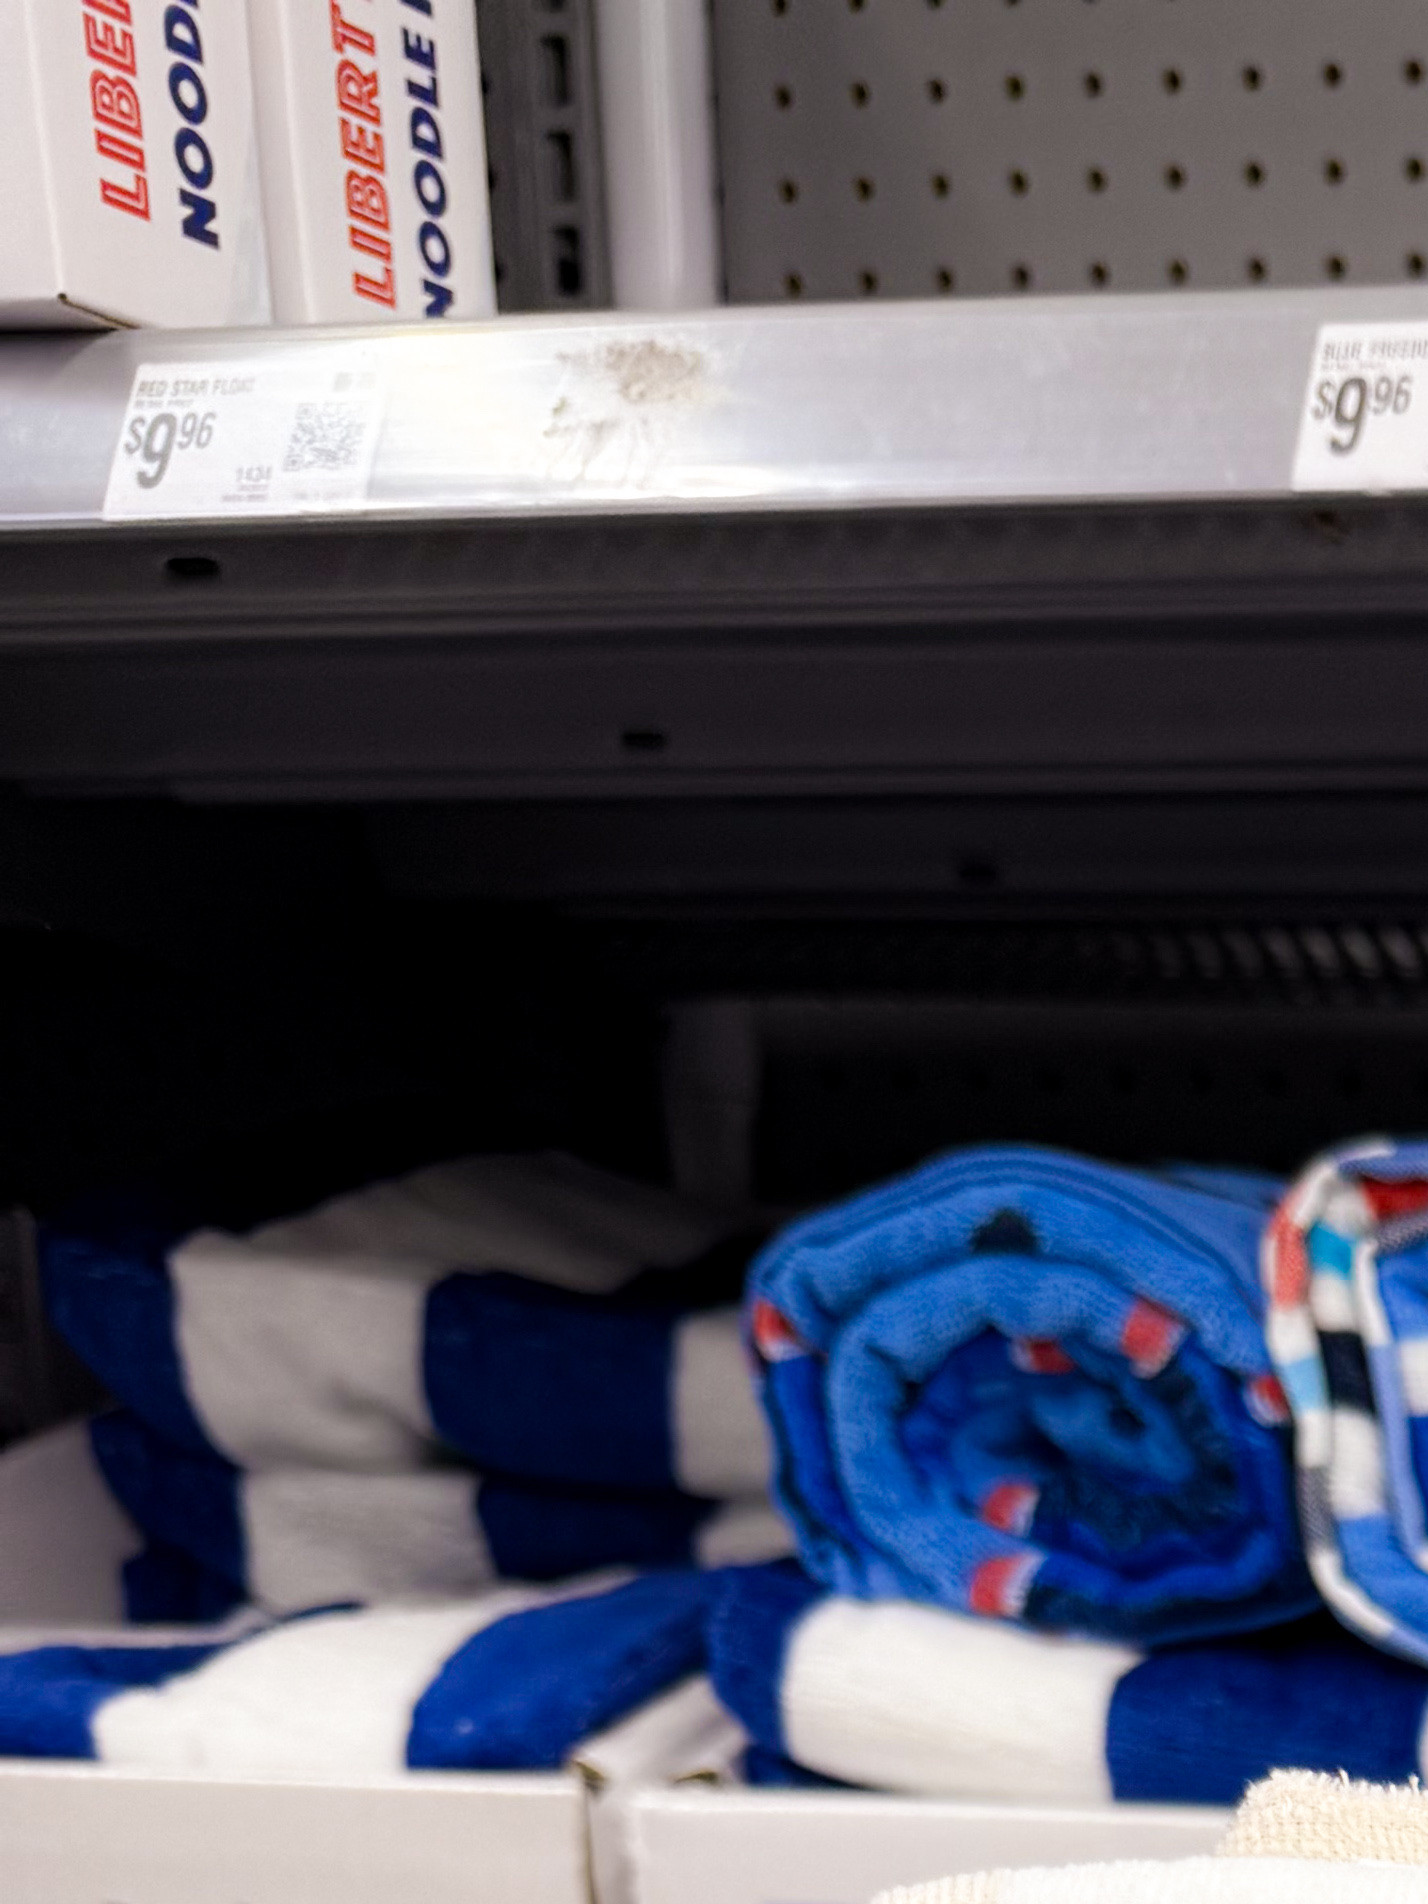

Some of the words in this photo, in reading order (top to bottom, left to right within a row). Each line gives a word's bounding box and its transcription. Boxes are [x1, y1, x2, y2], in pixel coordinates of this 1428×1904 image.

[82, 0, 151, 222] LIBE
[164, 0, 221, 250] NOOD
[329, 0, 396, 310] LIBERT
[404, 28, 454, 319] NOODLE
